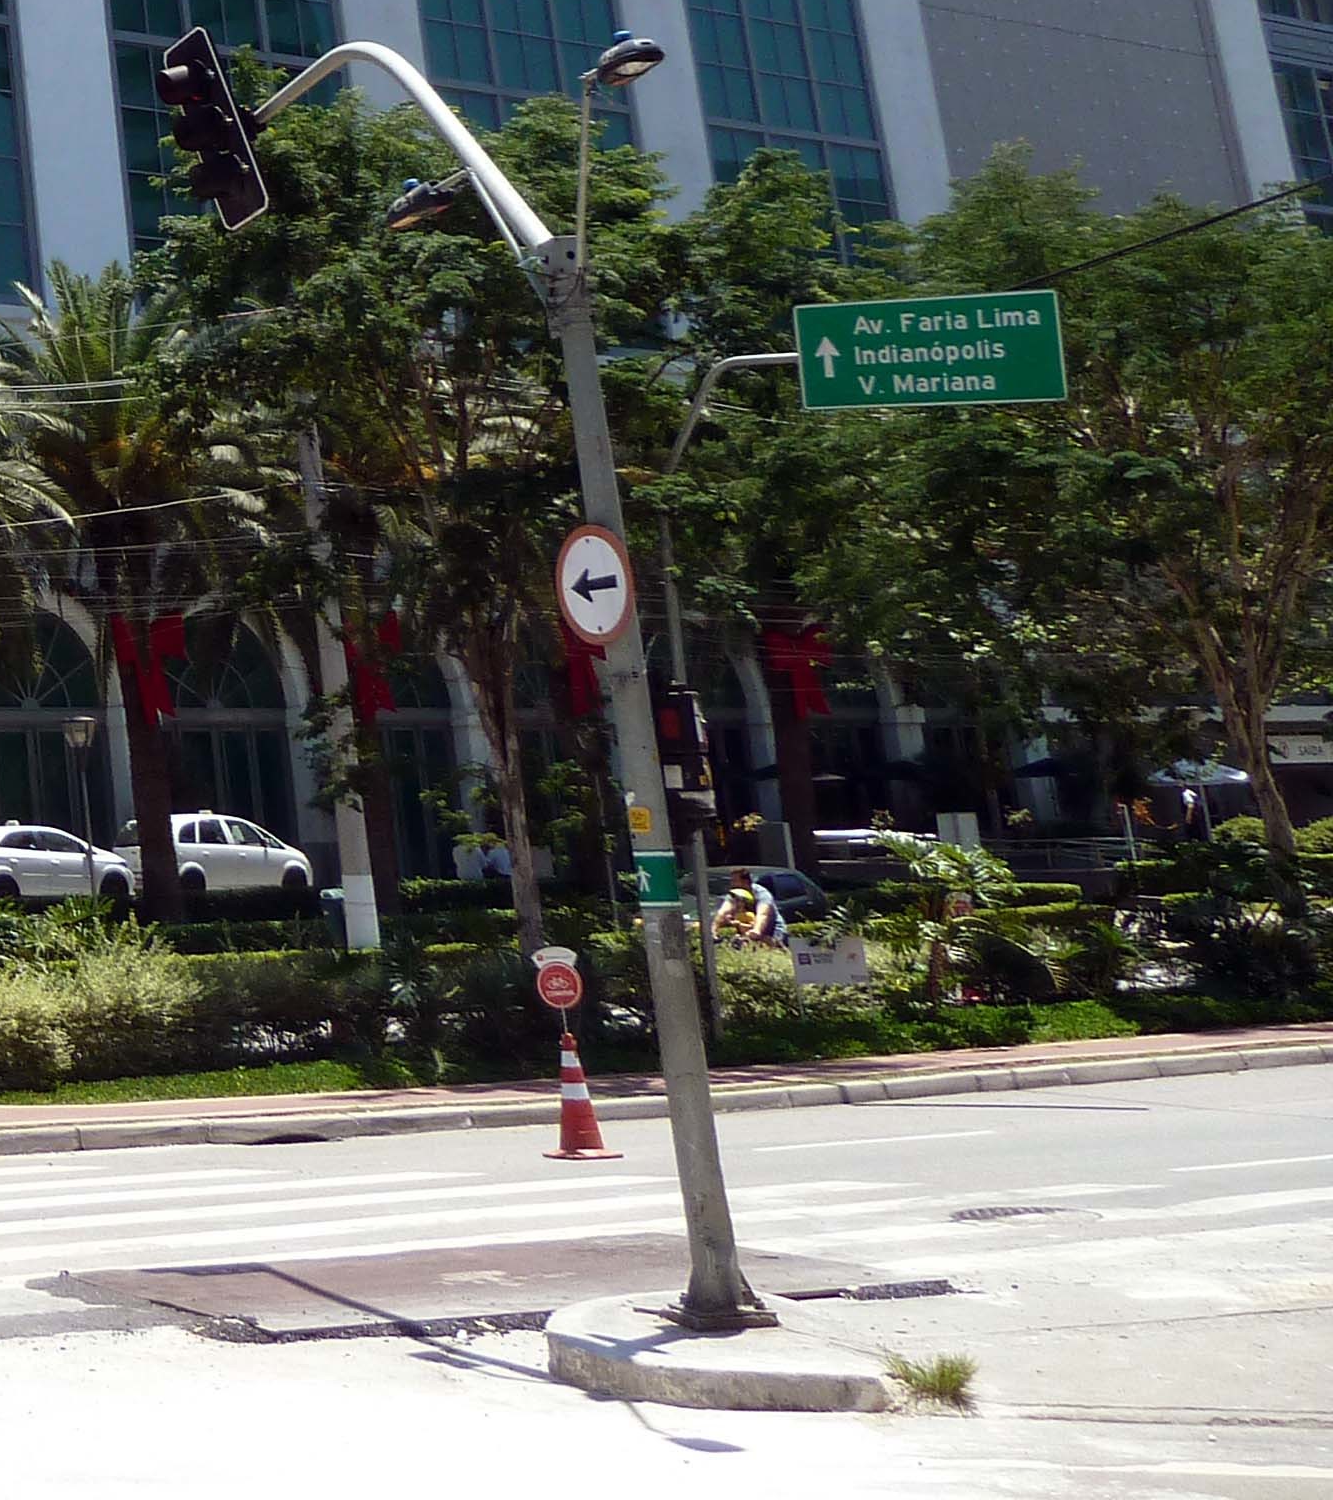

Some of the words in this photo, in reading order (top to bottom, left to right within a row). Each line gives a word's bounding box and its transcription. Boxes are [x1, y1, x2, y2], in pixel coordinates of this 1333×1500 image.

[853, 315, 891, 335] Av.
[900, 310, 968, 333] Faria
[977, 308, 1041, 329] Lima
[854, 339, 1006, 366] Indianópolis
[858, 375, 885, 396] V.
[893, 373, 996, 394] Mariana
